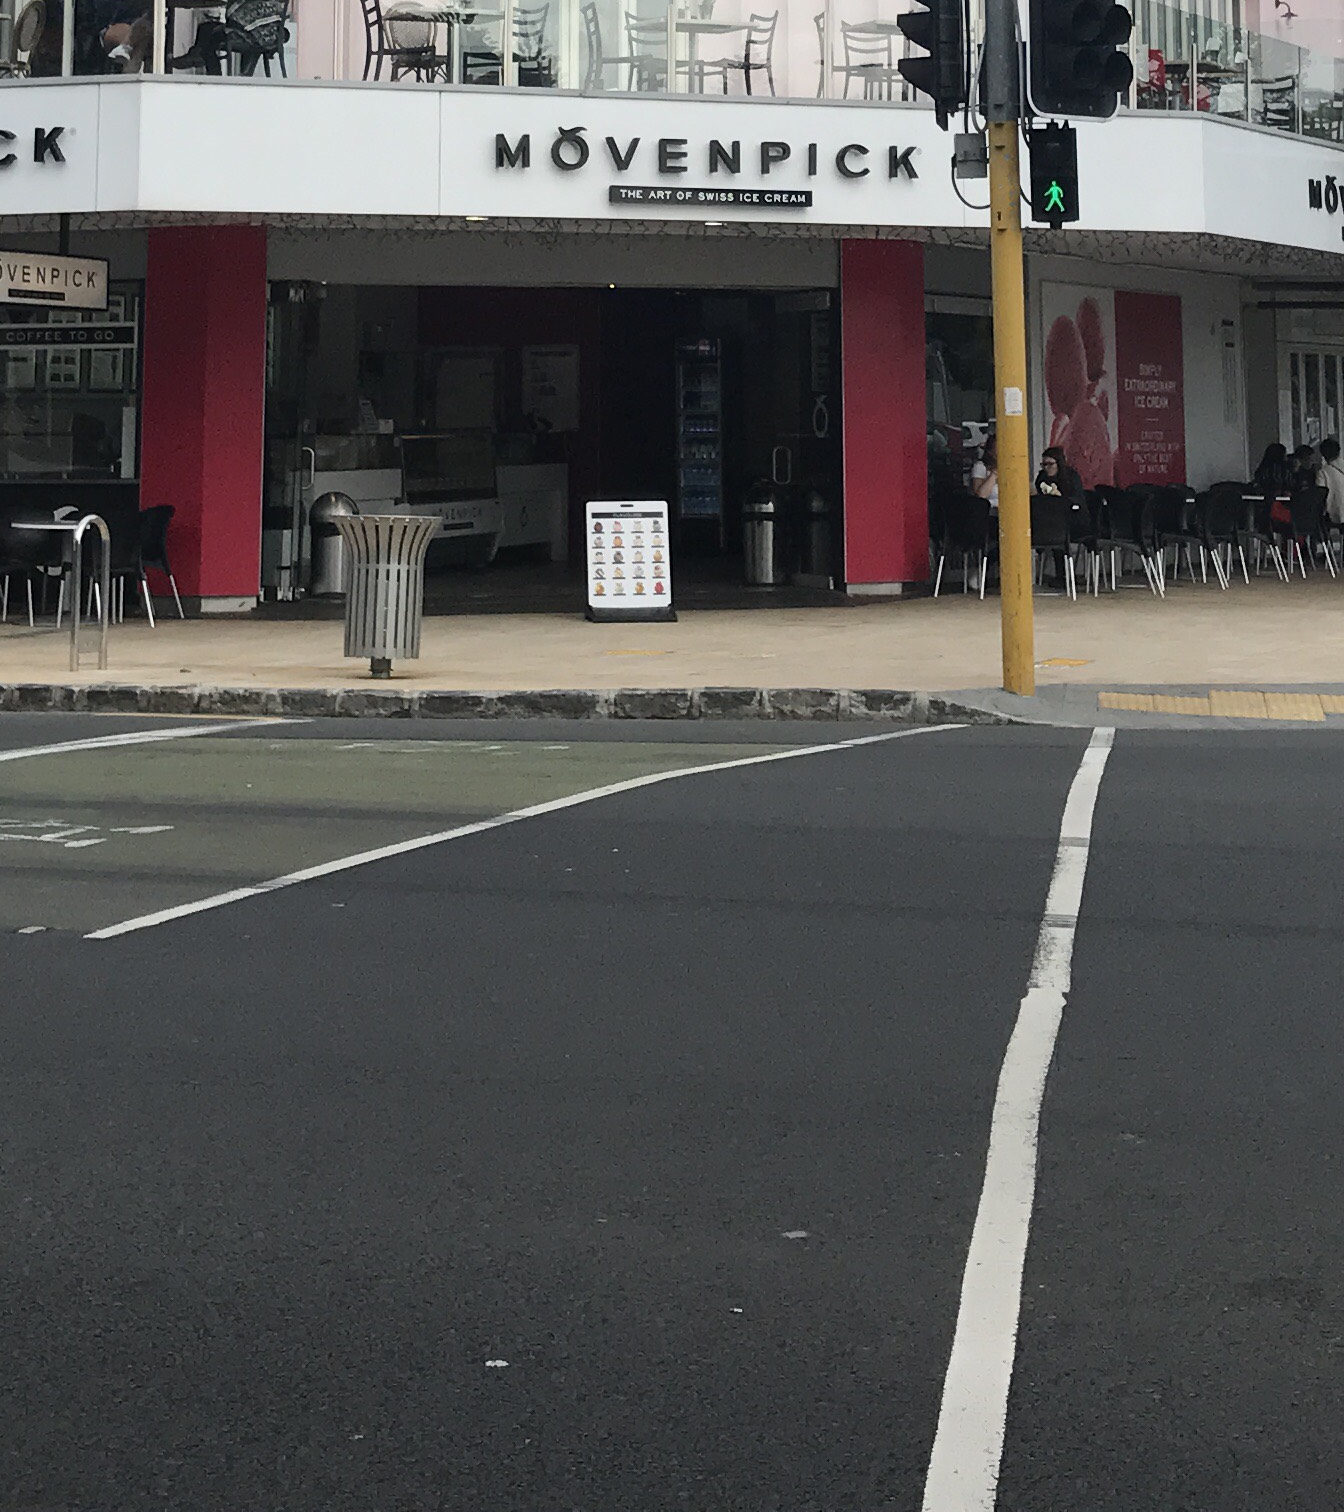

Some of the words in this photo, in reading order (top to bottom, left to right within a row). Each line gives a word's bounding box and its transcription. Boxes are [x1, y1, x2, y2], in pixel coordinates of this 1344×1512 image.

[619, 189, 644, 200] THE
[648, 190, 671, 201] ART
[675, 191, 693, 201] OF
[697, 192, 735, 203] SWISS
[739, 193, 760, 204] ICE
[764, 194, 806, 205] CREAM
[6, 331, 63, 342] COFFEE
[69, 331, 87, 341] TO
[94, 330, 115, 341] GO
